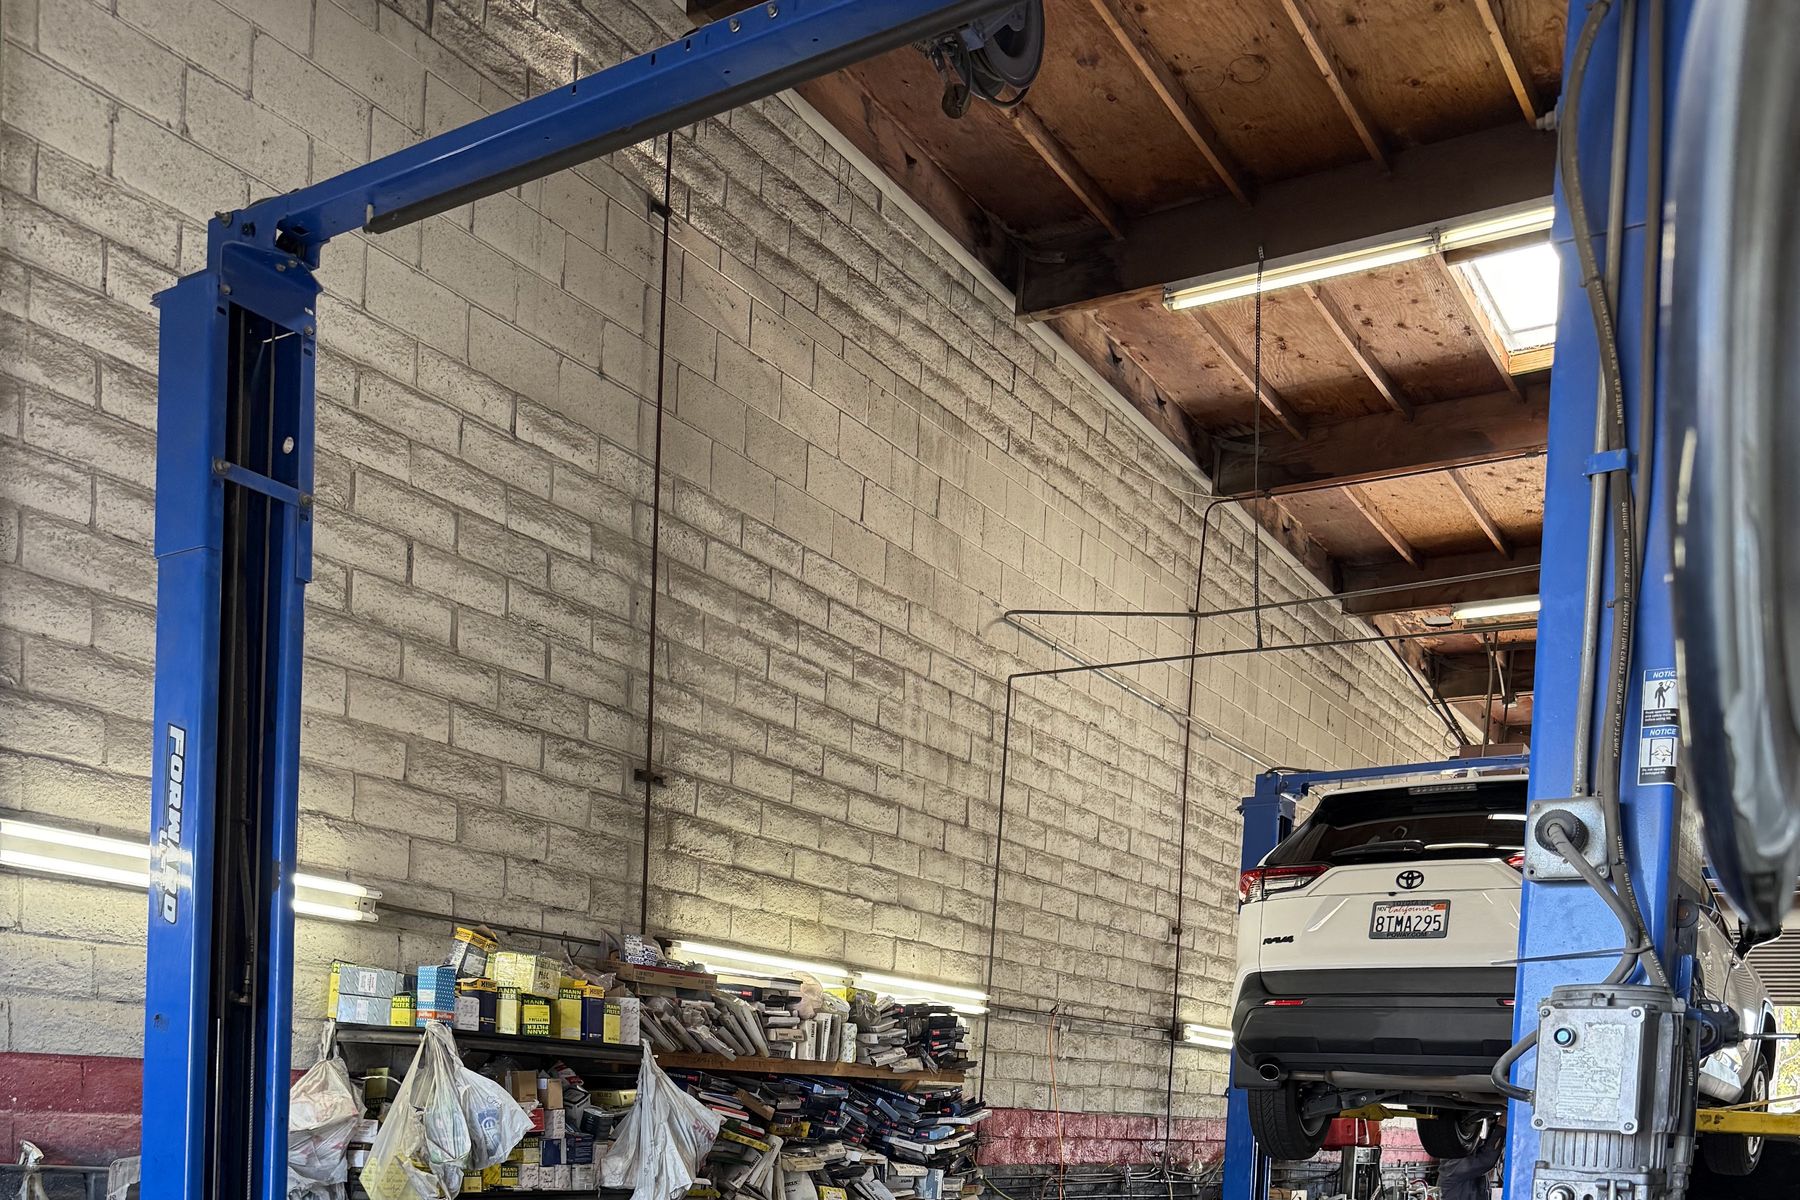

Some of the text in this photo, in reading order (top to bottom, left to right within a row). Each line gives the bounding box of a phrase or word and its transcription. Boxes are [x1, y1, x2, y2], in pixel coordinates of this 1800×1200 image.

[1652, 670, 1676, 679] NOTIC
[1649, 727, 1677, 737] NOTICE
[163, 722, 186, 924] FORWARD
[1387, 905, 1430, 915] California
[1375, 914, 1442, 932] 8TMA295
